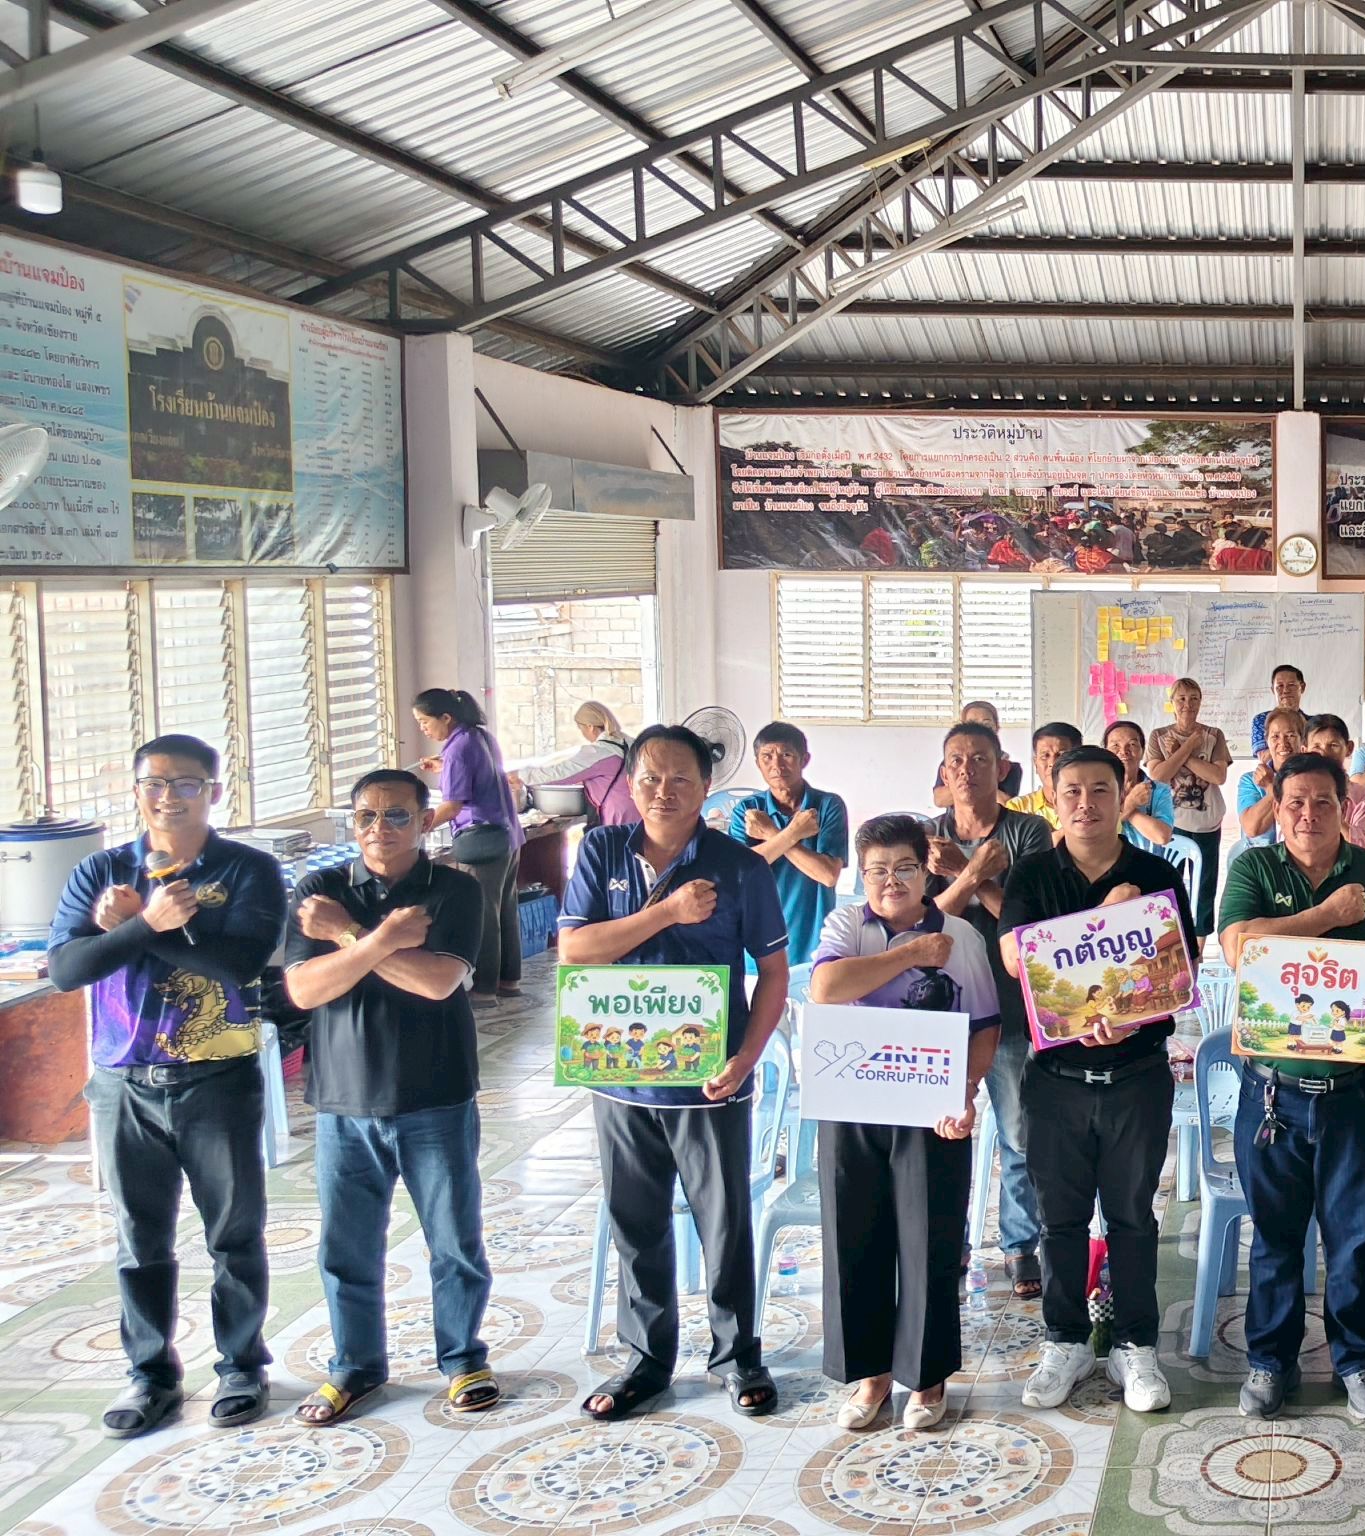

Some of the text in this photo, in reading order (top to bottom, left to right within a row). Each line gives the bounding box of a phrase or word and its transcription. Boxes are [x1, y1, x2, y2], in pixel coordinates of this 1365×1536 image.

[952, 423, 1043, 445] ประวัติหมู่บ้าน
[1005, 454, 1010, 462] 2
[1053, 925, 1156, 970] กตัญญู
[1279, 960, 1358, 997] สุจริต
[588, 984, 701, 1016] พอเพียง
[860, 1044, 950, 1074] ANTI
[855, 1068, 949, 1086] CORRUPTION
